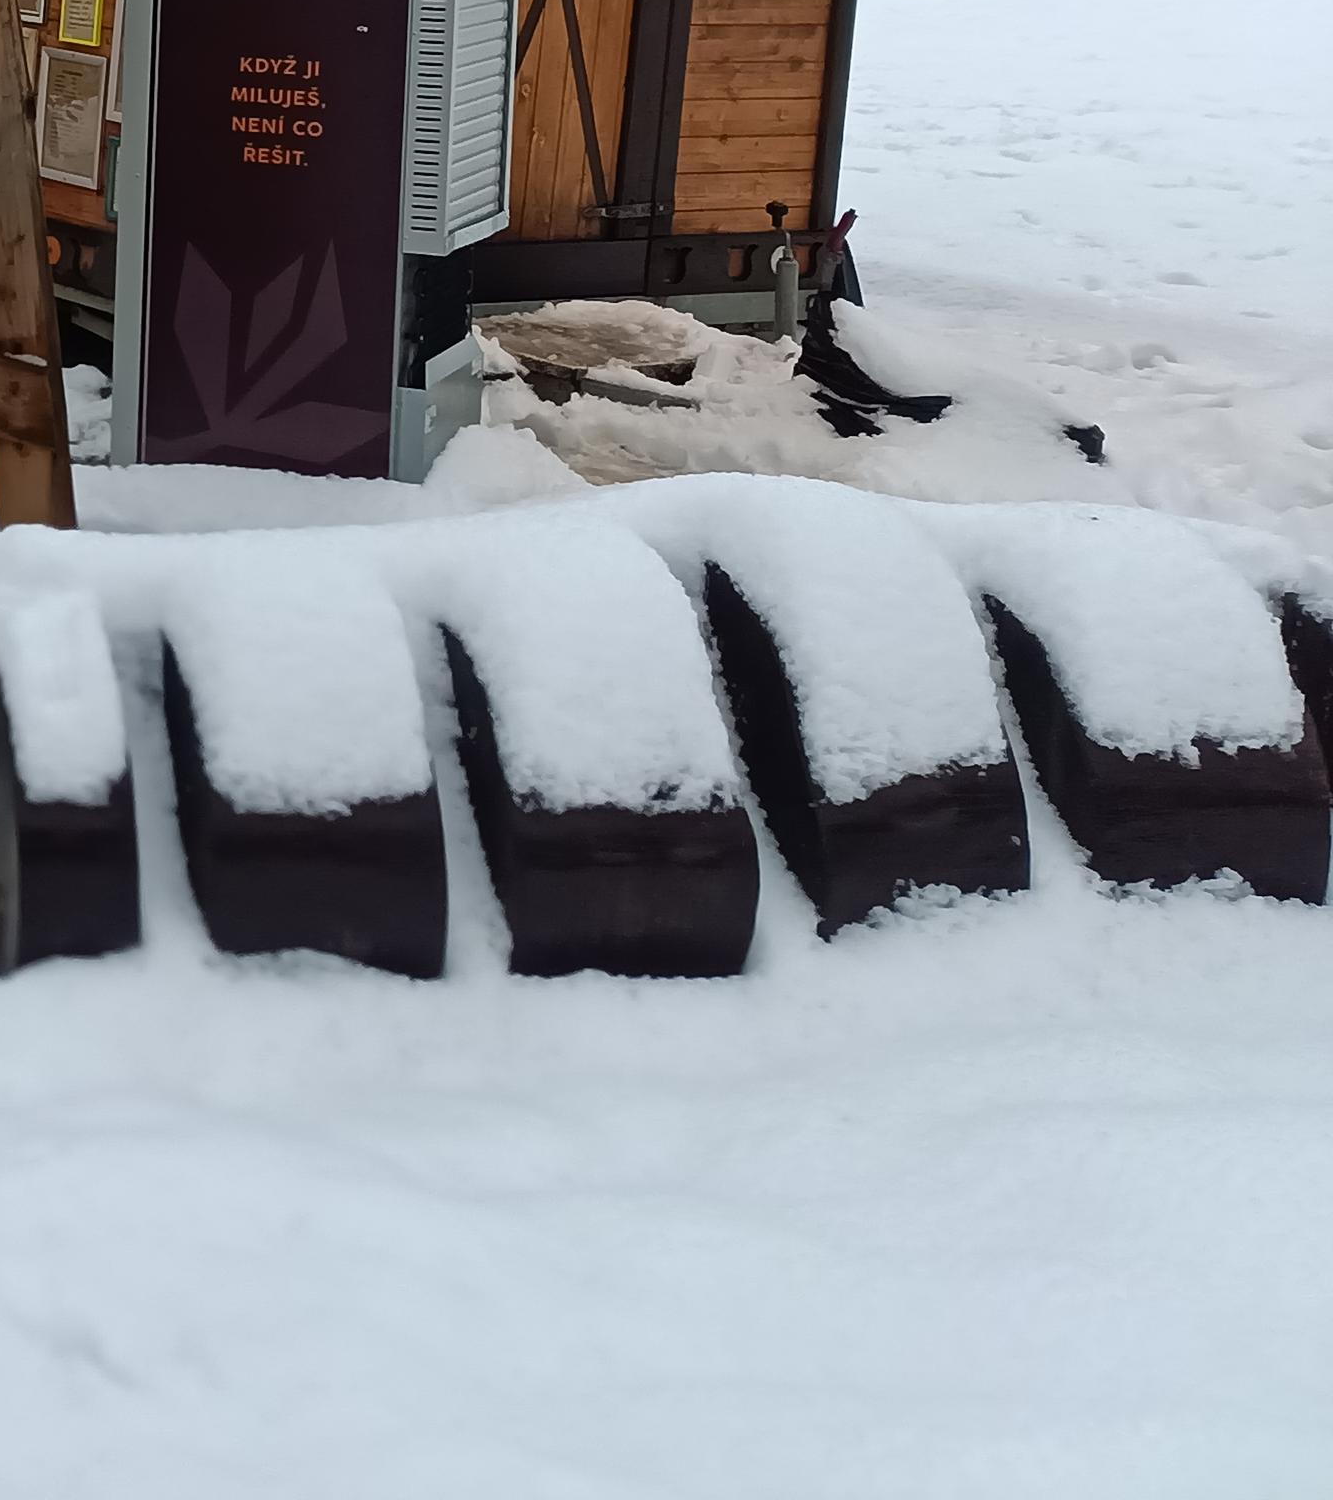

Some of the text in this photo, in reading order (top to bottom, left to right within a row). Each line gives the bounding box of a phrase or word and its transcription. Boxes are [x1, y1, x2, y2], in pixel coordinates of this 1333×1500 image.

[240, 55, 320, 79] KDYŽ JI
[231, 86, 326, 109] MILUJEŠ,
[232, 115, 323, 137] NENÍ CO
[243, 142, 309, 166] ŘEŠIT.
